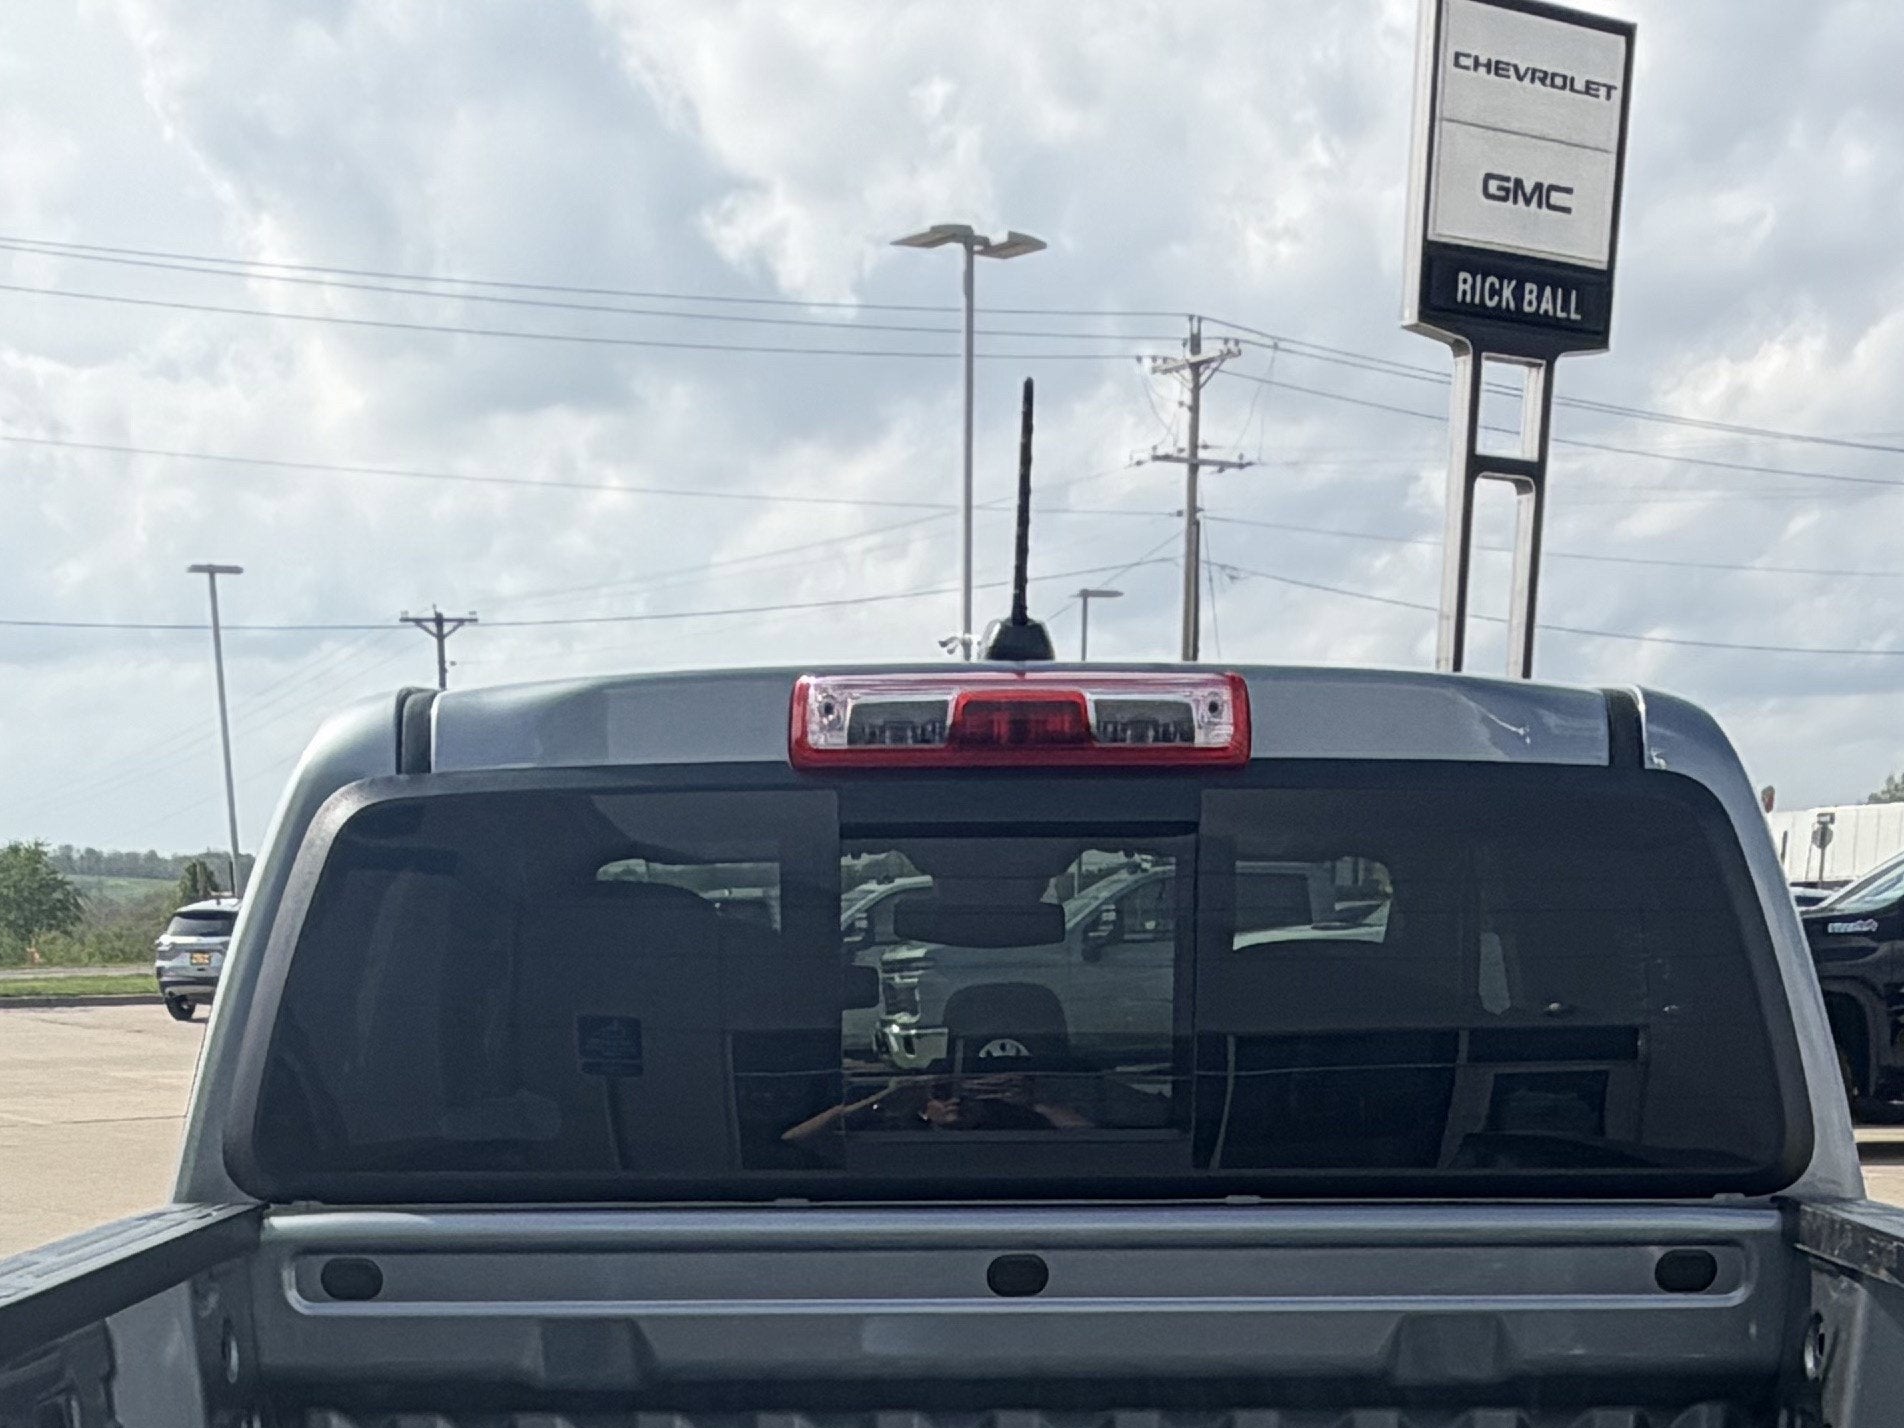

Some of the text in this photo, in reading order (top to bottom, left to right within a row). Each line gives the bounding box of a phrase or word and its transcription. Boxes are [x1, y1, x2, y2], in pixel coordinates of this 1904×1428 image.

[1452, 51, 1618, 102] CHEVROLET
[1481, 171, 1574, 215] GMC
[1456, 270, 1583, 321] RICK BALL
